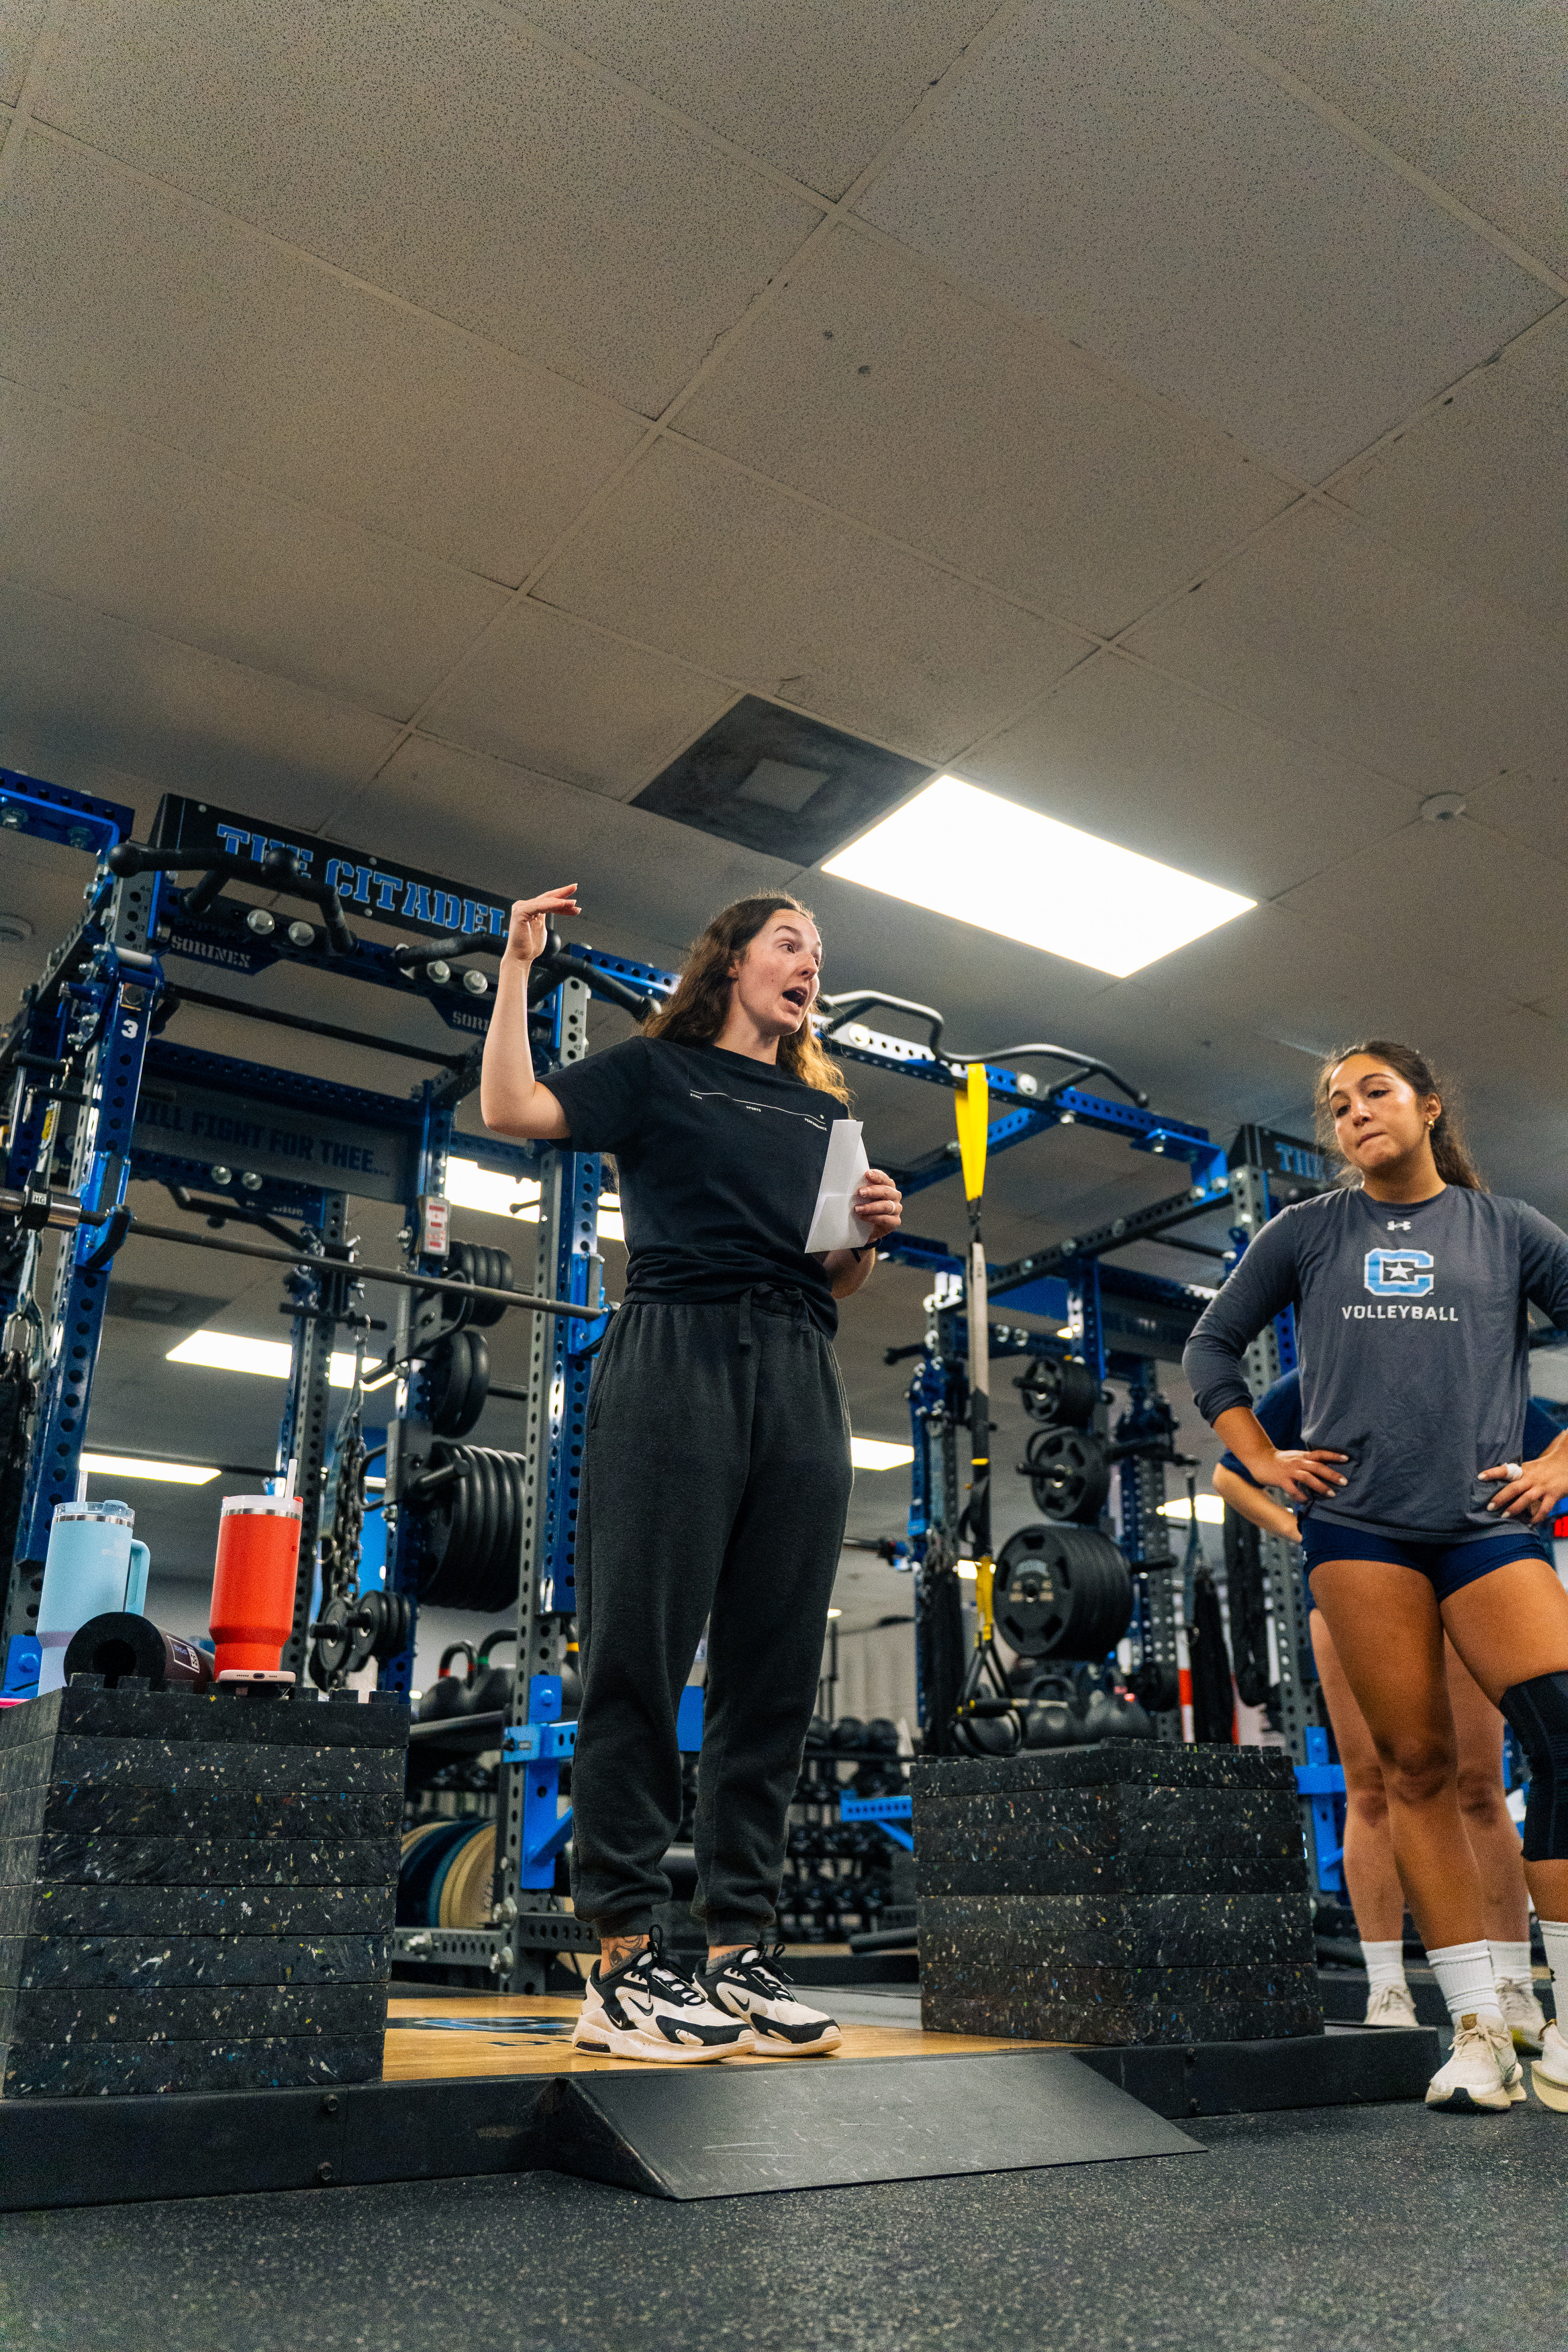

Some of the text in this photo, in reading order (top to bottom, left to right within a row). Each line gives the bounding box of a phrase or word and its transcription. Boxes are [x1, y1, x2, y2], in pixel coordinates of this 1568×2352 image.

[324, 857, 509, 938] CITADEL
[171, 935, 251, 969] SORINEX
[121, 1019, 138, 1039] 3
[452, 1010, 491, 1032] SORI
[193, 1111, 264, 1149] FIGHT
[269, 1128, 313, 1161] FOR
[804, 1118, 828, 1131] PERFORMANCE
[1364, 1247, 1434, 1297] C
[1341, 1304, 1459, 1322] VOLLEYBALL
